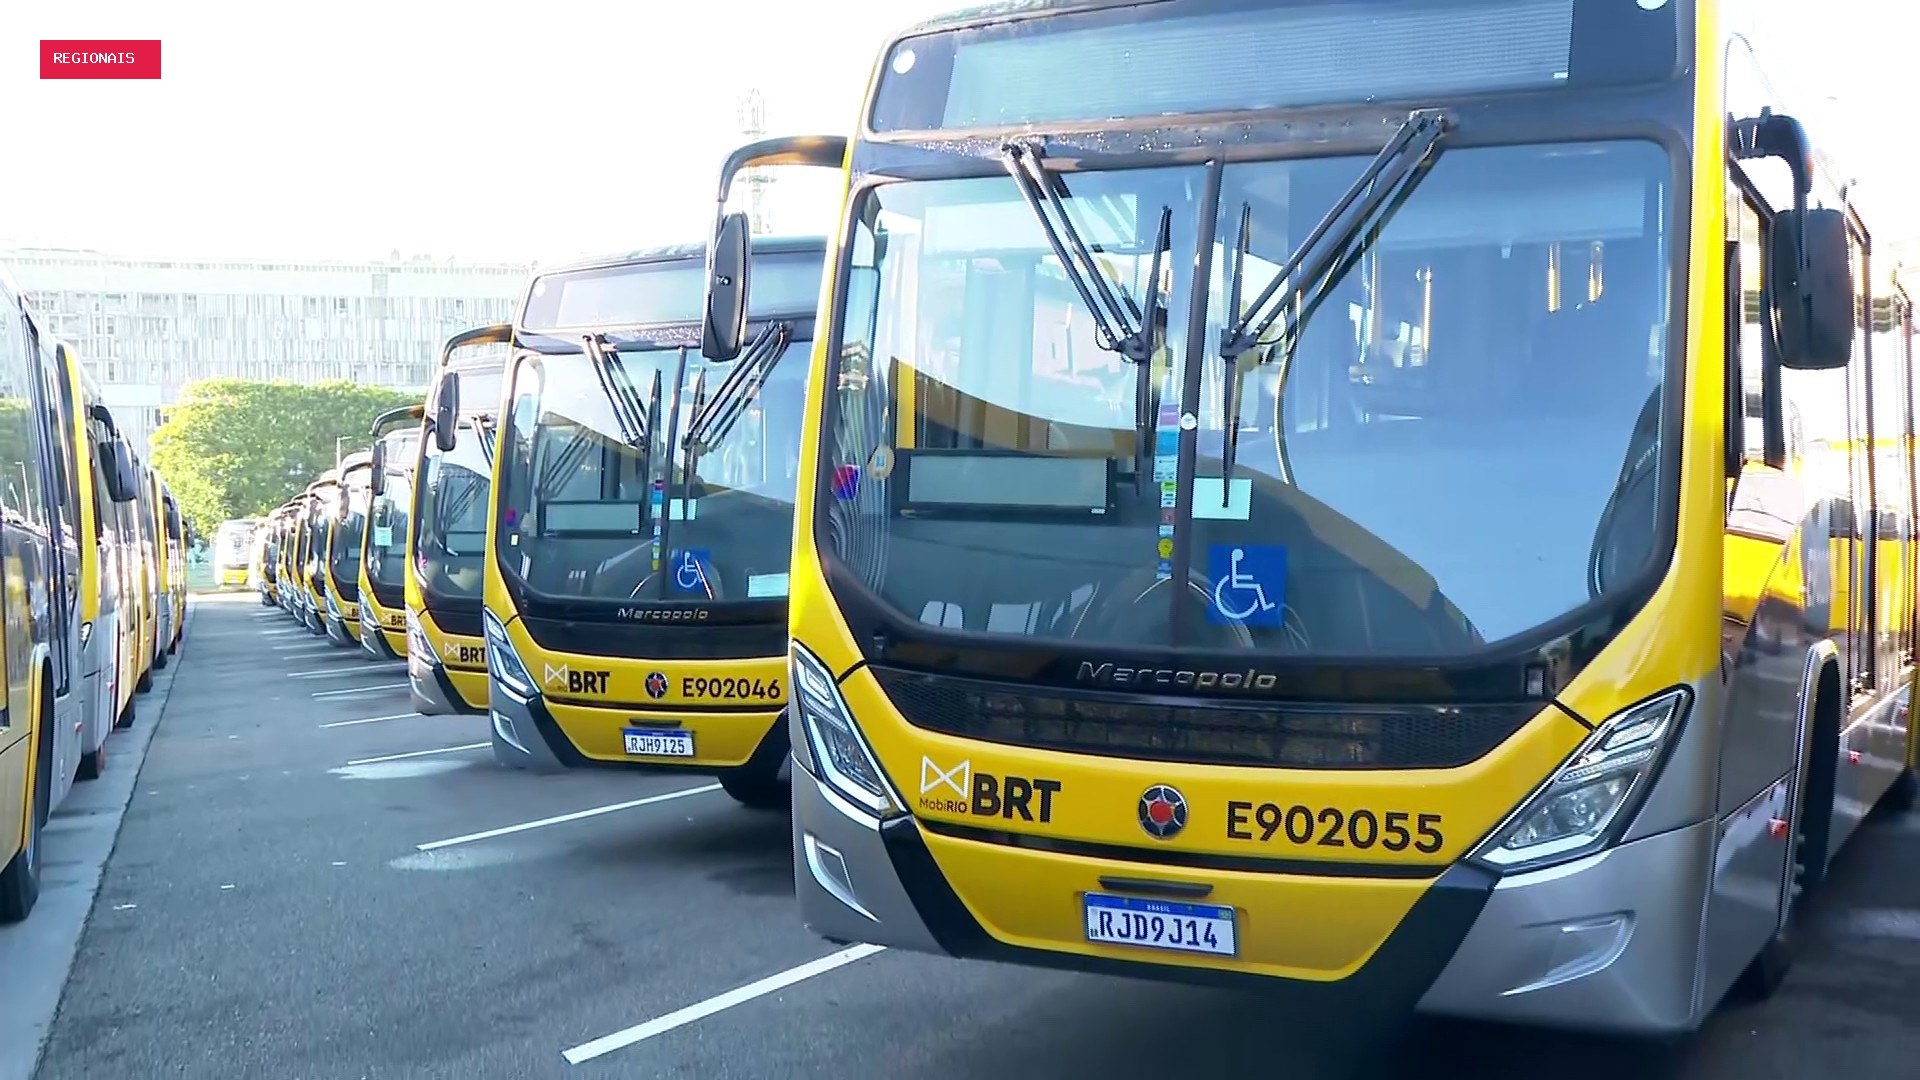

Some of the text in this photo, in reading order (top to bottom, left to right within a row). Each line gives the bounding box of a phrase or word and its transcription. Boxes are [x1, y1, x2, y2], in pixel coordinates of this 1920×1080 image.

[617, 607, 709, 621] Marcopolo
[569, 670, 611, 694] BRT
[682, 677, 781, 700] E902046
[1076, 660, 1278, 691] Marcopolo
[919, 797, 968, 813] MobiRIO
[971, 772, 1062, 823] BRT
[1226, 800, 1444, 854] E902055
[1098, 910, 1219, 949] RJD9J14
